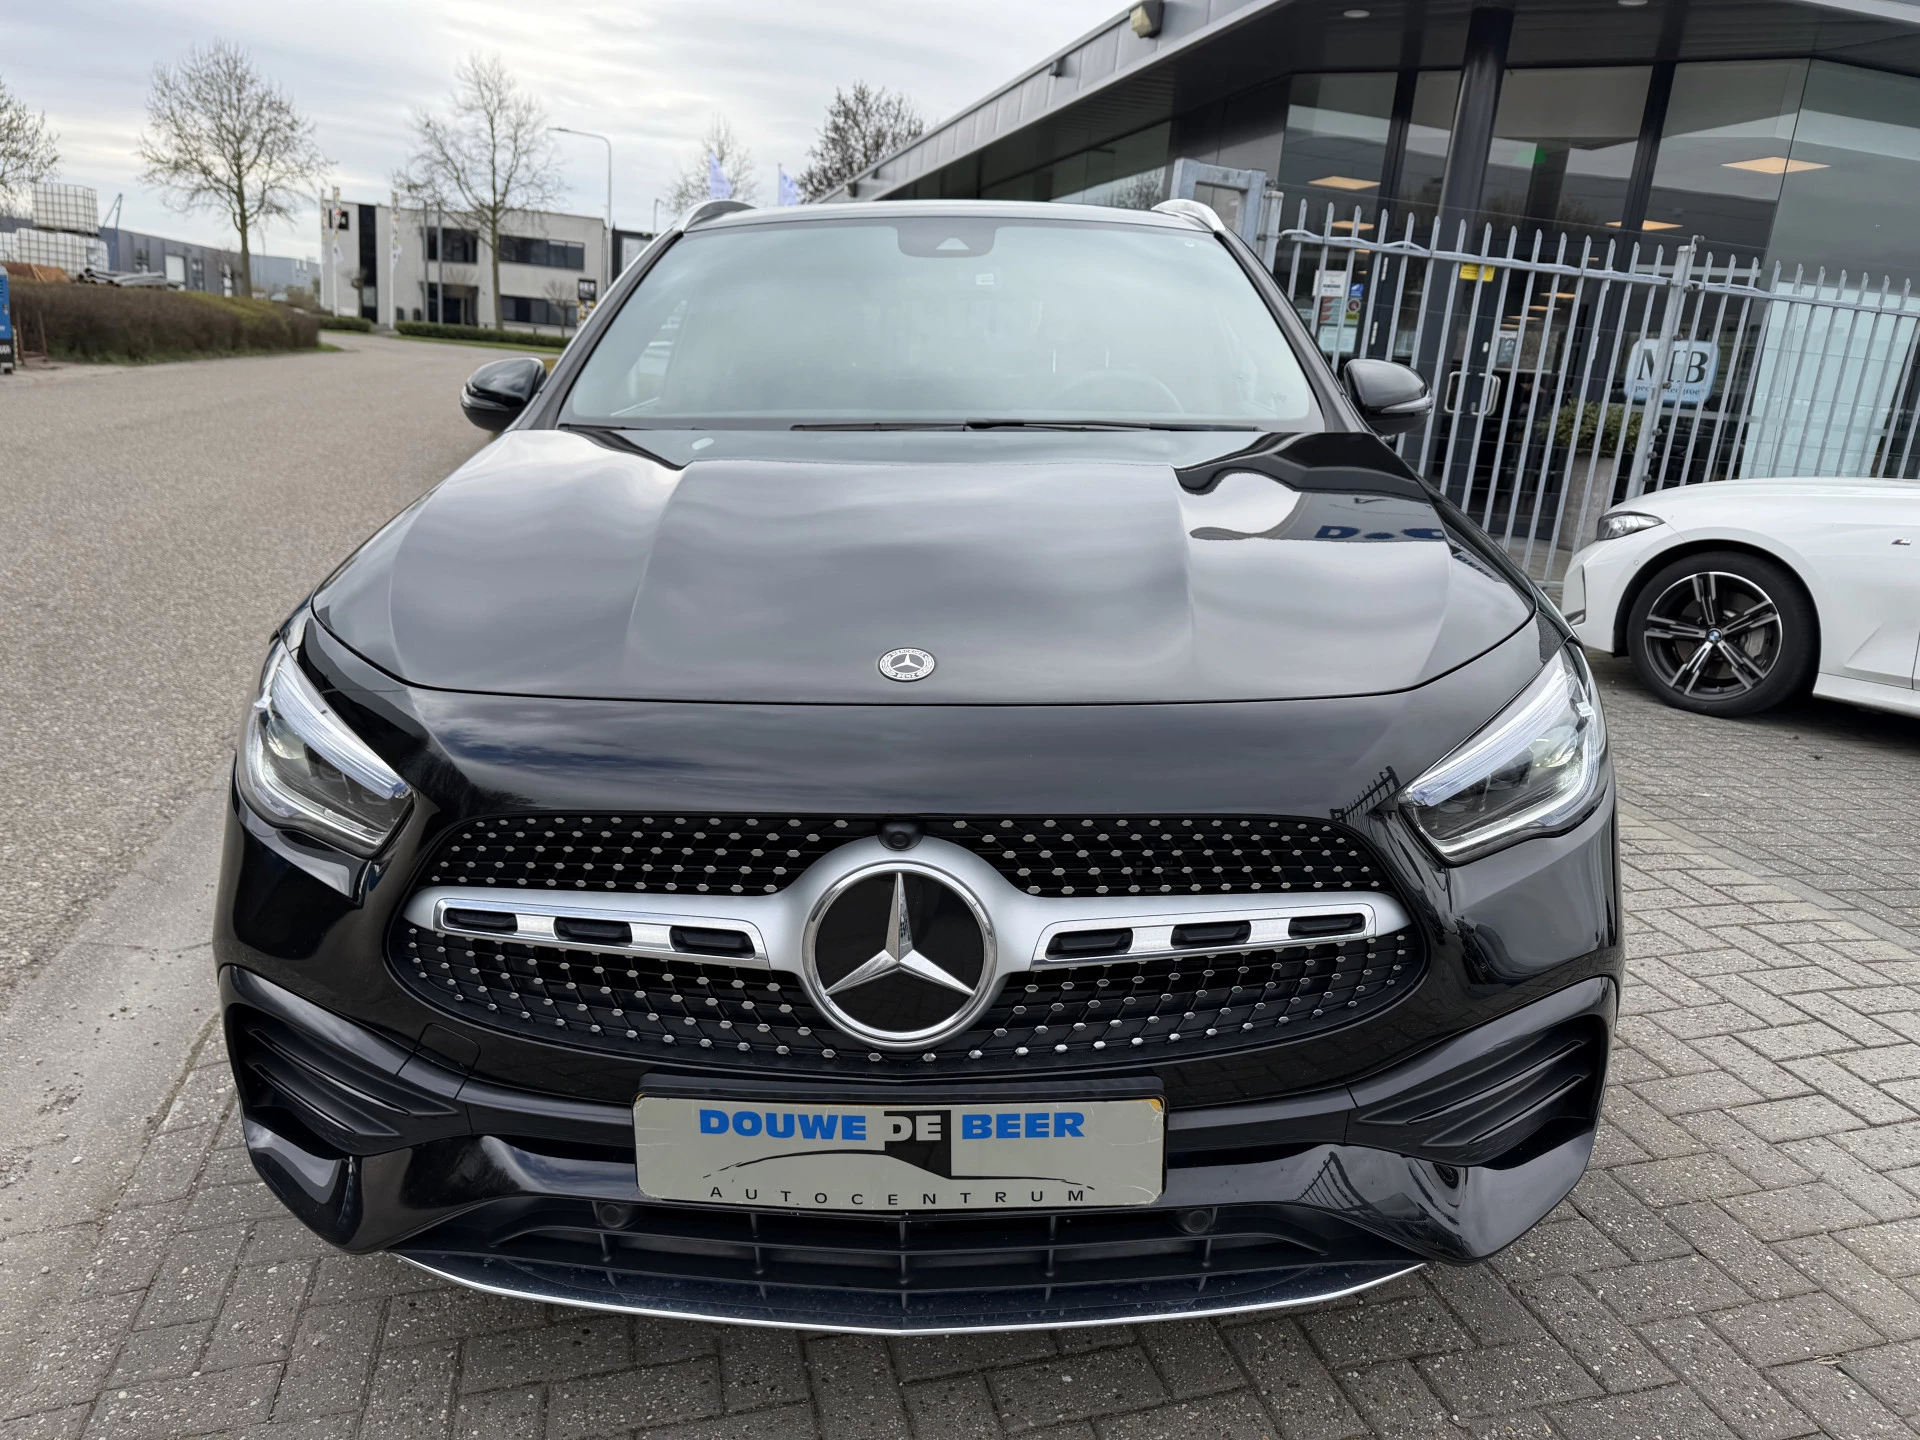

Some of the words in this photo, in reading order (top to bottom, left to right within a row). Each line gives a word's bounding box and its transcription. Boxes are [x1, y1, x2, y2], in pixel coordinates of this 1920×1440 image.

[700, 1109, 867, 1141] DOUWE
[885, 1115, 941, 1142] DE
[962, 1112, 1085, 1140] BEER
[710, 1186, 1083, 1206] AUTOCENTRUM
